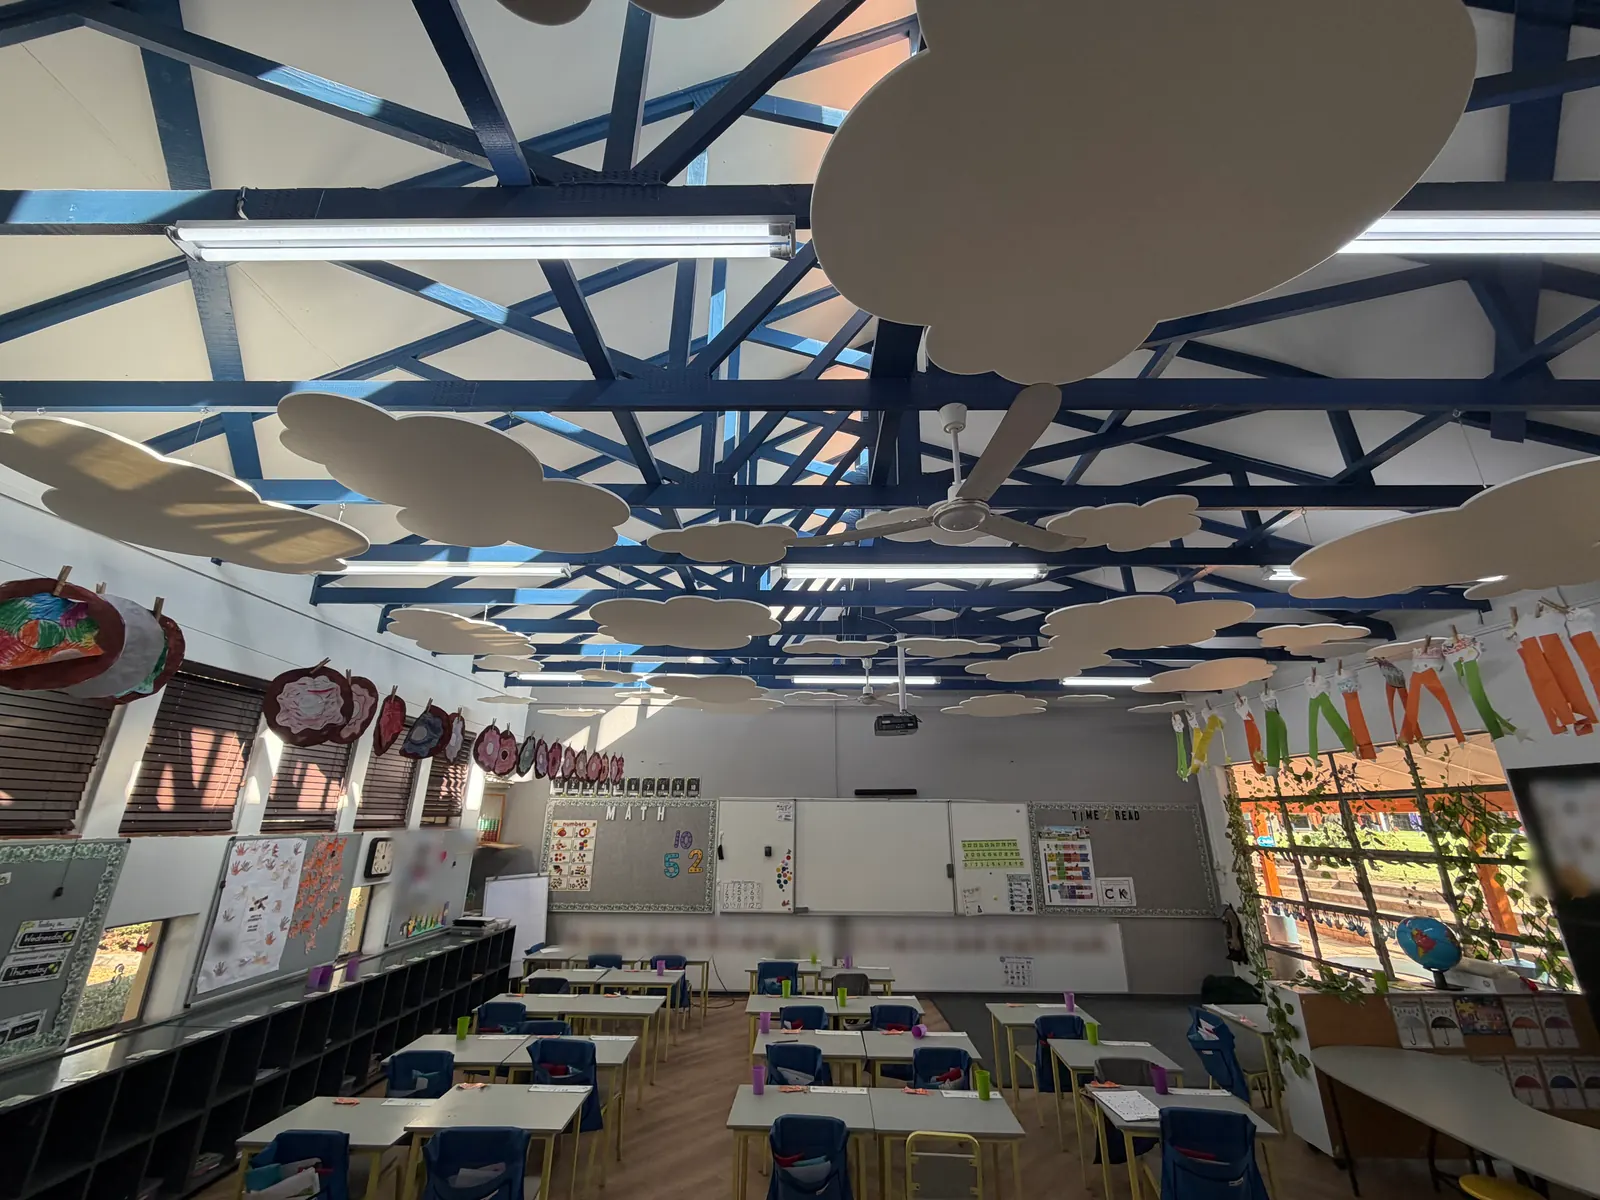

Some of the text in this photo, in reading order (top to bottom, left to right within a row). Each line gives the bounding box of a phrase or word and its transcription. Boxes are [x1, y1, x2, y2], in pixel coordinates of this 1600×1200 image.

[605, 805, 666, 821] MATH
[1072, 809, 1099, 821] TIME
[1115, 810, 1140, 821] READ
[674, 830, 693, 849] 10
[664, 849, 704, 878] 5 2
[24, 932, 65, 943] Wednesday
[9, 964, 48, 976] Thursday
